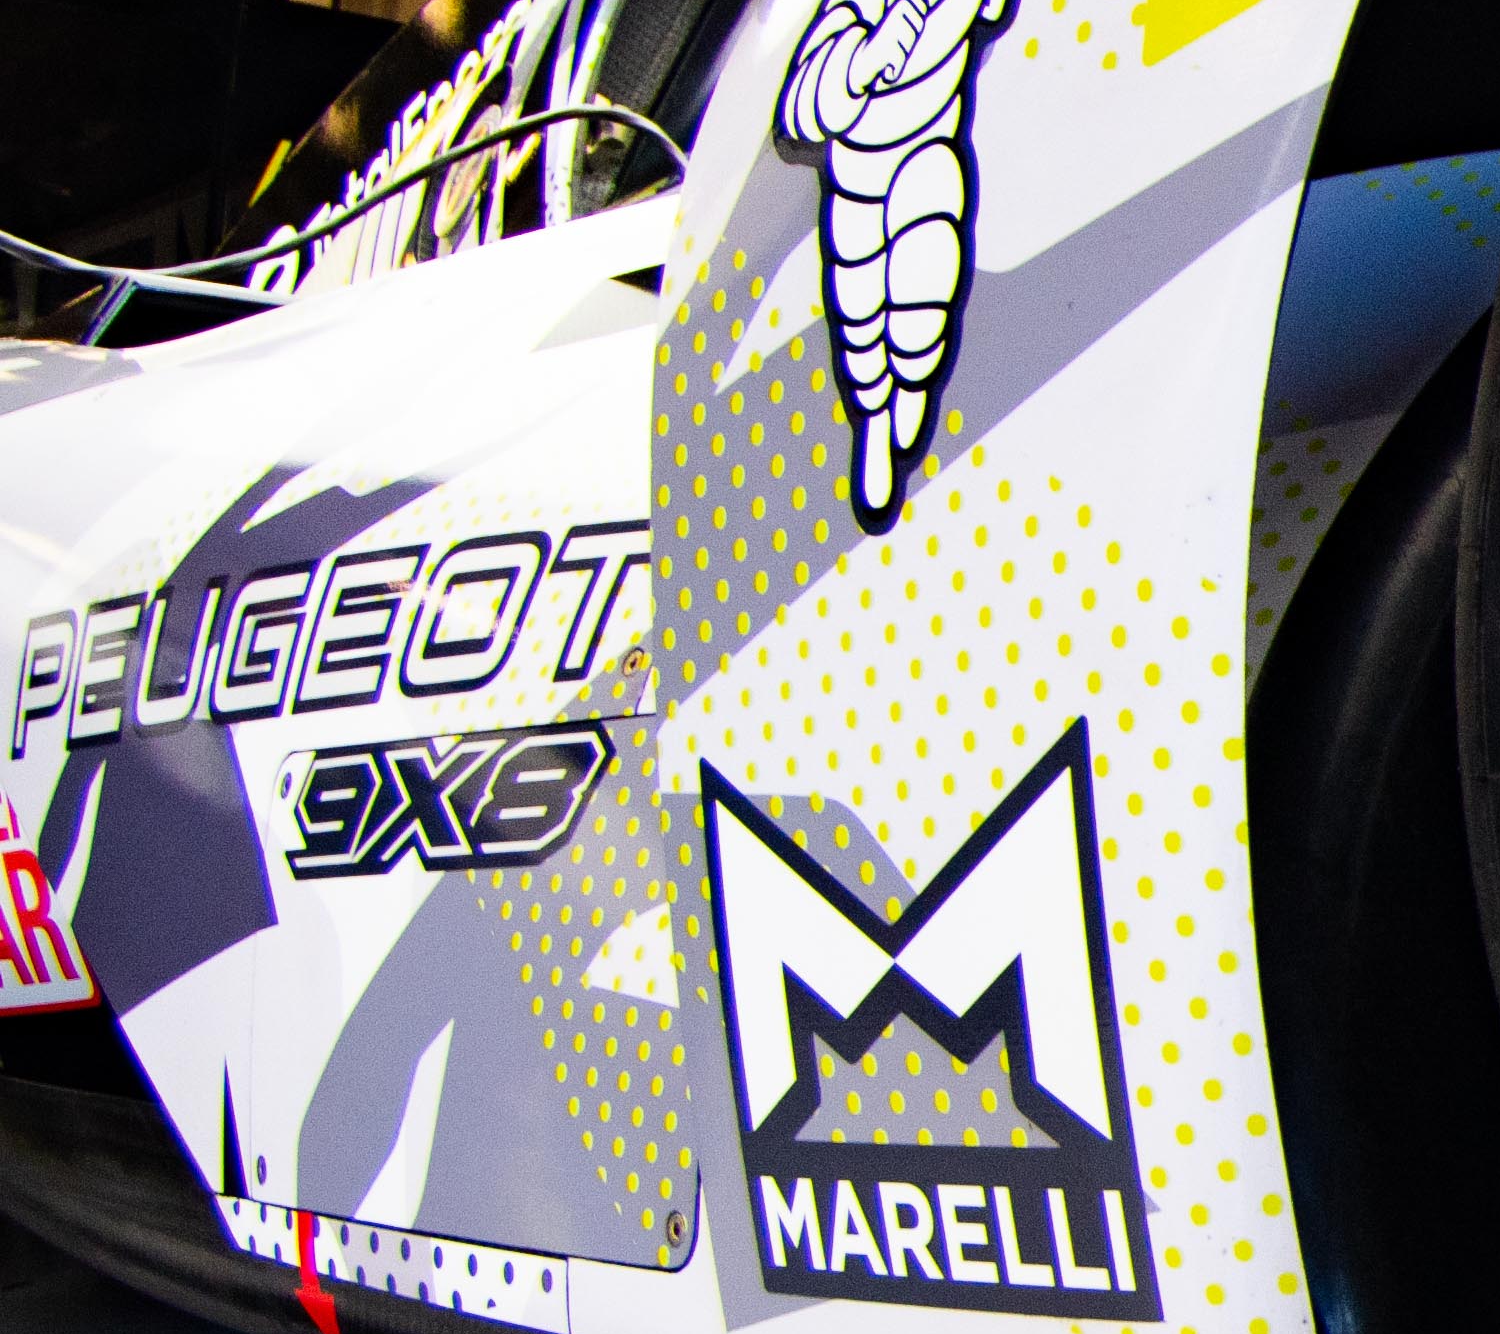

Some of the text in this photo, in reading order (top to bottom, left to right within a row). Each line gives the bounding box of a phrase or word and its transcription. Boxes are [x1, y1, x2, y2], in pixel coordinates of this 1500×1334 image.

[11, 518, 651, 761] PEUGEOT
[282, 720, 617, 881] 9X8
[756, 1172, 1138, 1293] MARELLI
